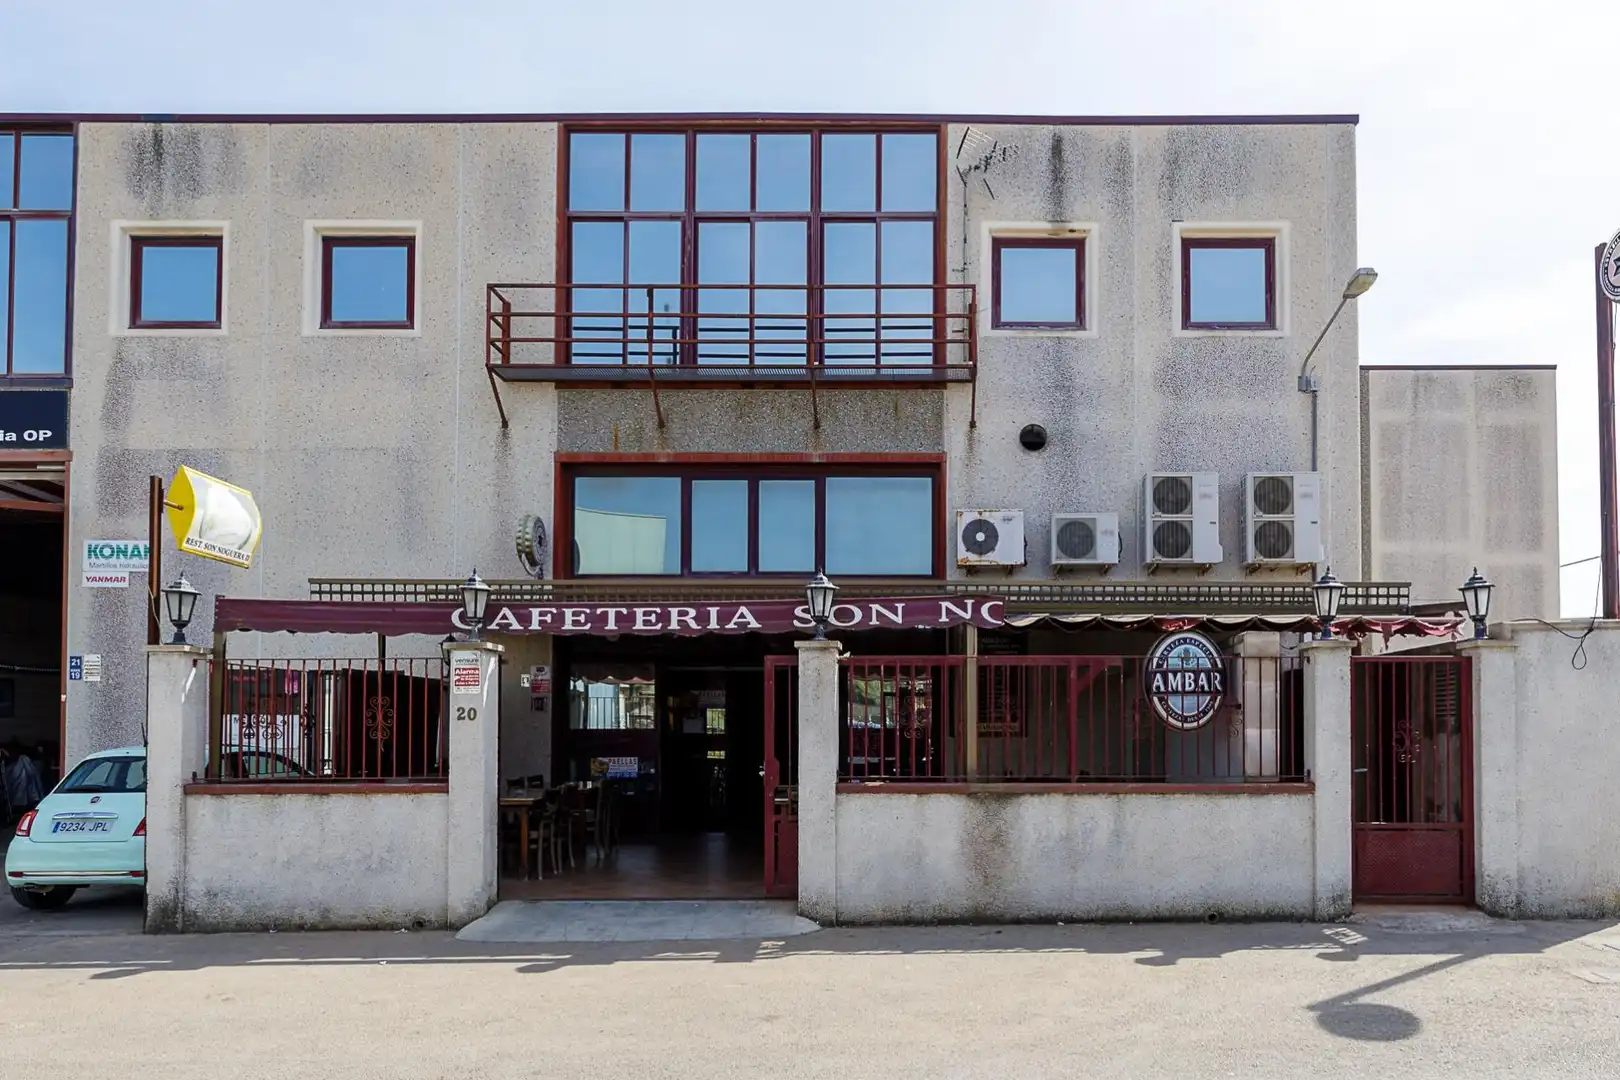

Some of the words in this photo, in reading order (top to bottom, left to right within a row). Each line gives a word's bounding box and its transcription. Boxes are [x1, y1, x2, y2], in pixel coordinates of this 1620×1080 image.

[23, 429, 53, 442] OP
[204, 542, 217, 552] SON
[85, 575, 127, 583] YANMAR
[451, 604, 762, 630] CAFETERIA
[792, 603, 906, 628] SON
[71, 658, 81, 666] 21
[70, 672, 80, 680] 19
[1152, 672, 1222, 692] AMBAR
[456, 706, 477, 721] 20
[60, 822, 86, 832] 9234
[89, 822, 108, 832] JPL
